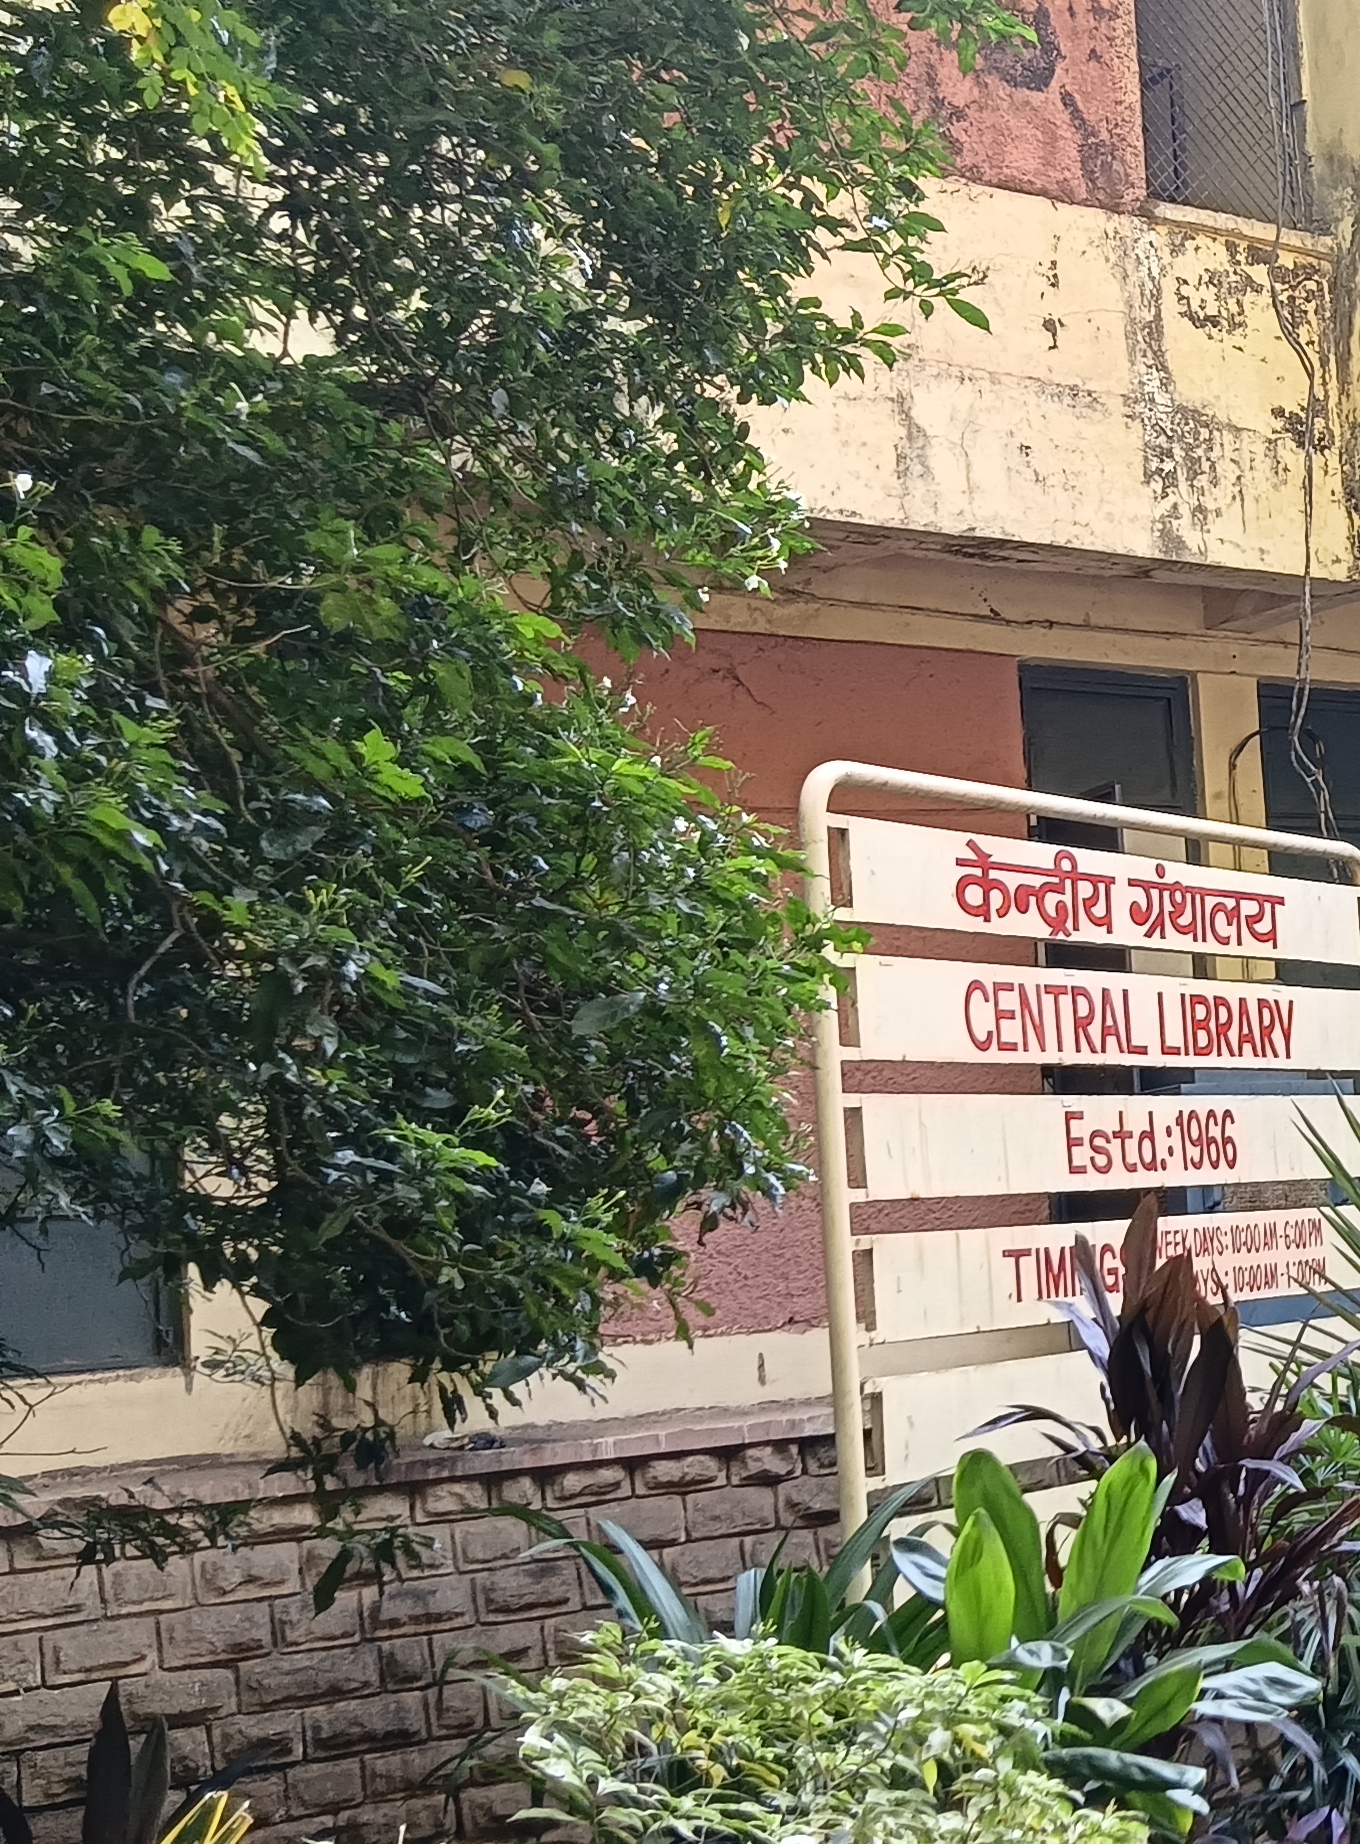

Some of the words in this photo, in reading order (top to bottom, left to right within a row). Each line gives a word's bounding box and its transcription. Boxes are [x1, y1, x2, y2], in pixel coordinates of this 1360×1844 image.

[956, 839, 1116, 938] केन्द्रीय
[1128, 863, 1285, 949] ग्रंथालय
[964, 979, 1148, 1055] CENTRAL
[1157, 991, 1294, 1059] LIBRARY
[1002, 1243, 1129, 1303] TIMIG
